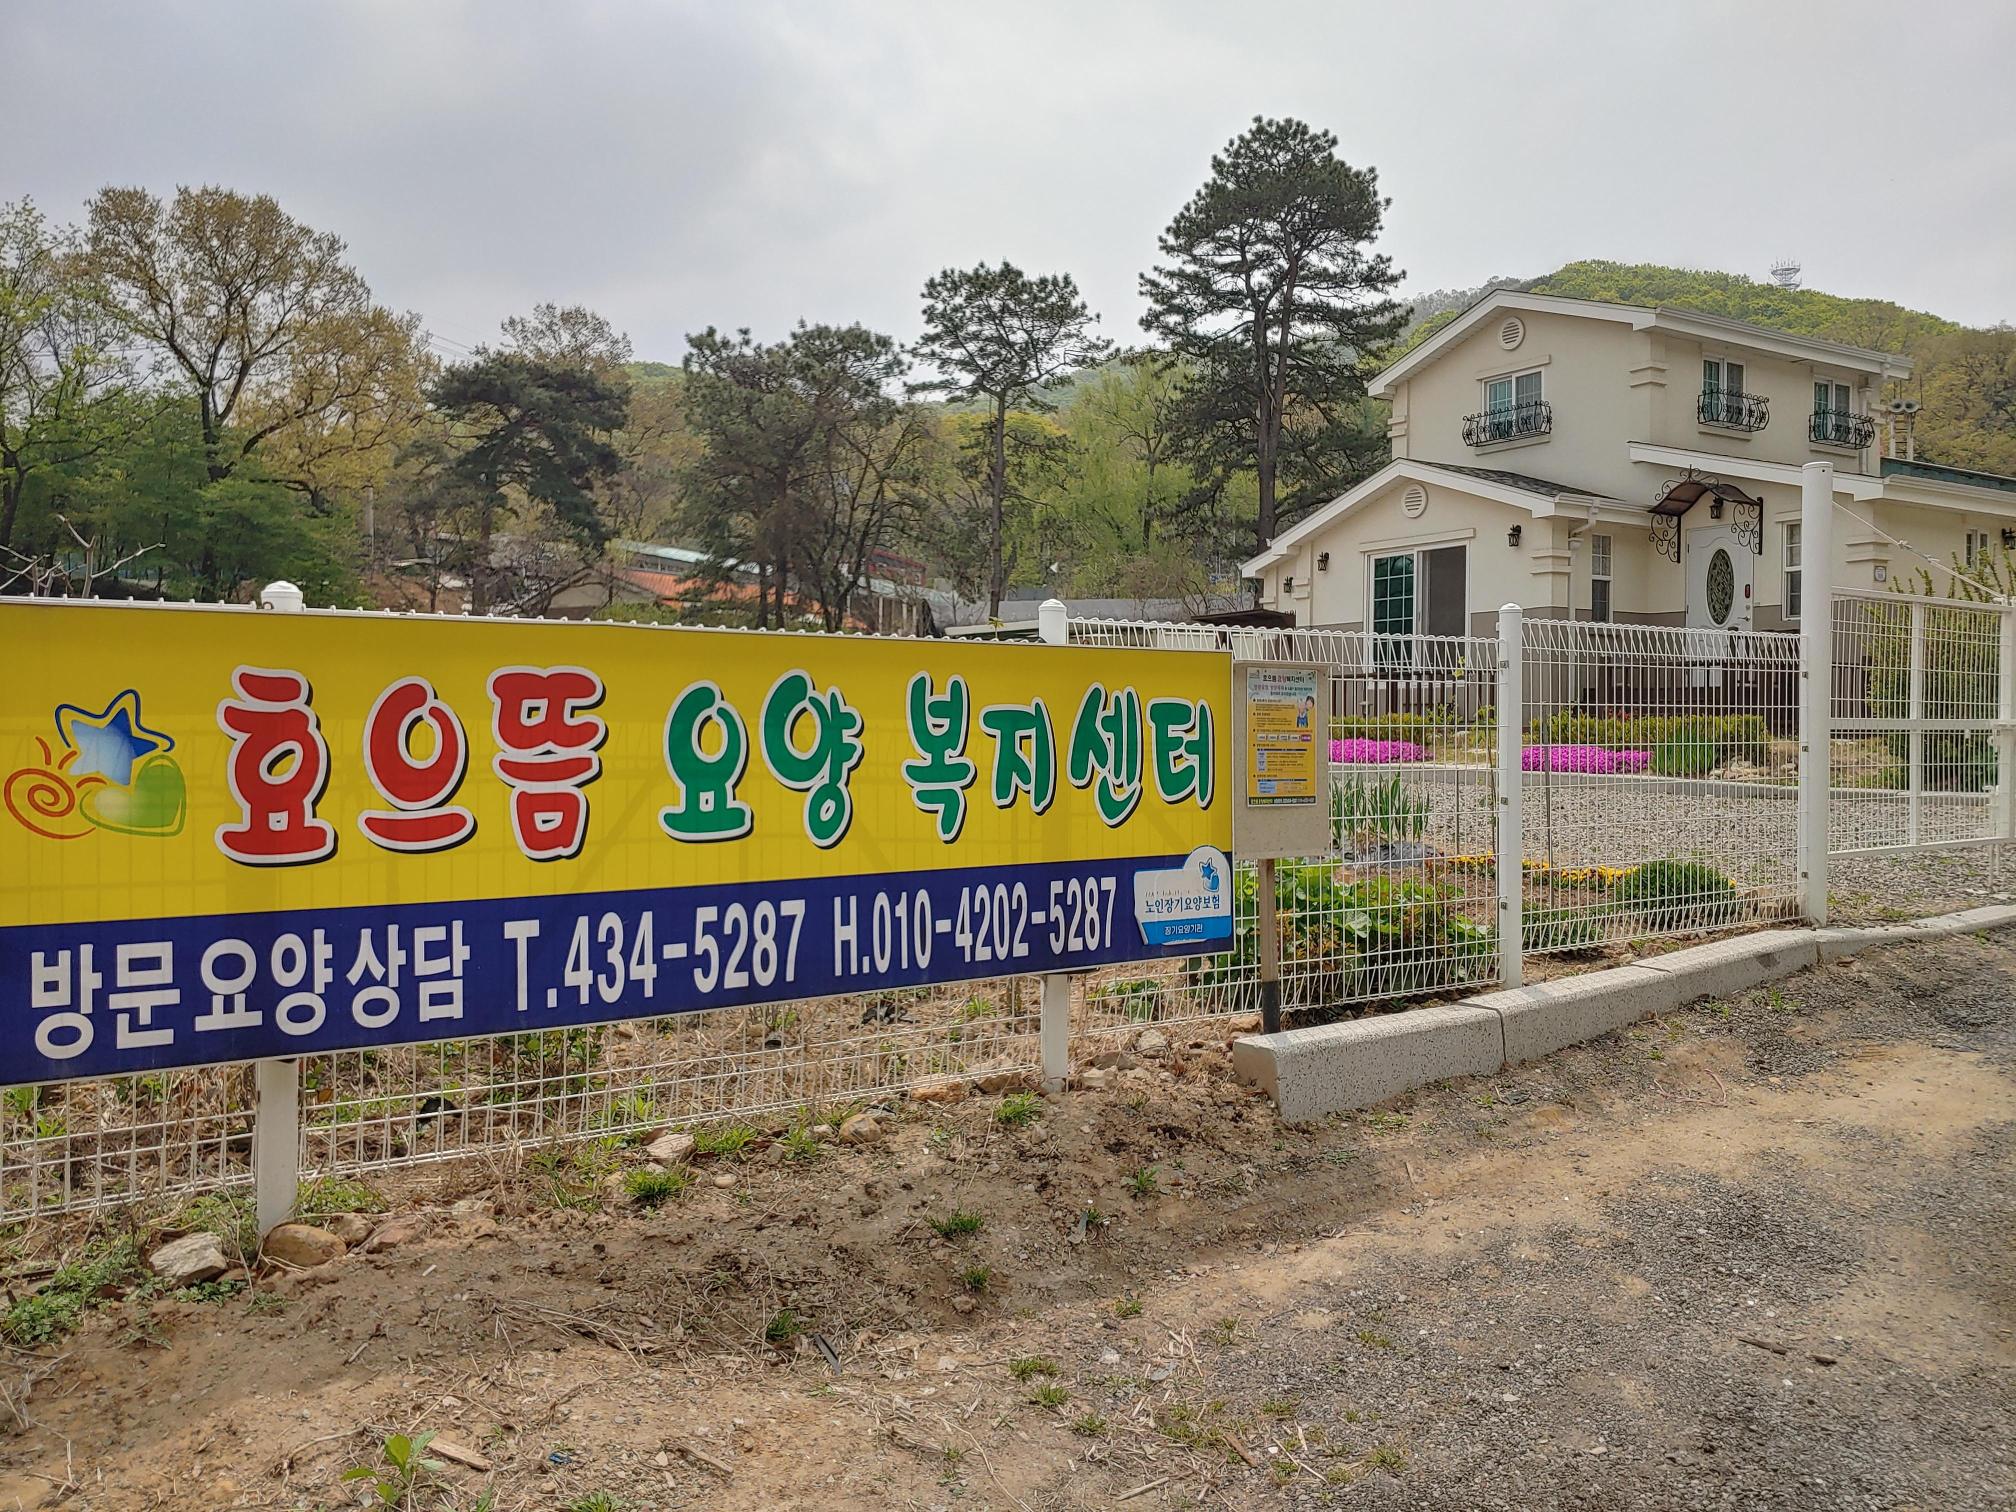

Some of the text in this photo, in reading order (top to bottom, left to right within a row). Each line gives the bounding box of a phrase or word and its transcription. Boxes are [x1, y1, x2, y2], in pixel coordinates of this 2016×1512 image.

[215, 664, 607, 867] 효으뜸
[834, 876, 1117, 976] H.010-4202-5287
[1145, 895, 1220, 914] 노인장기요양보험
